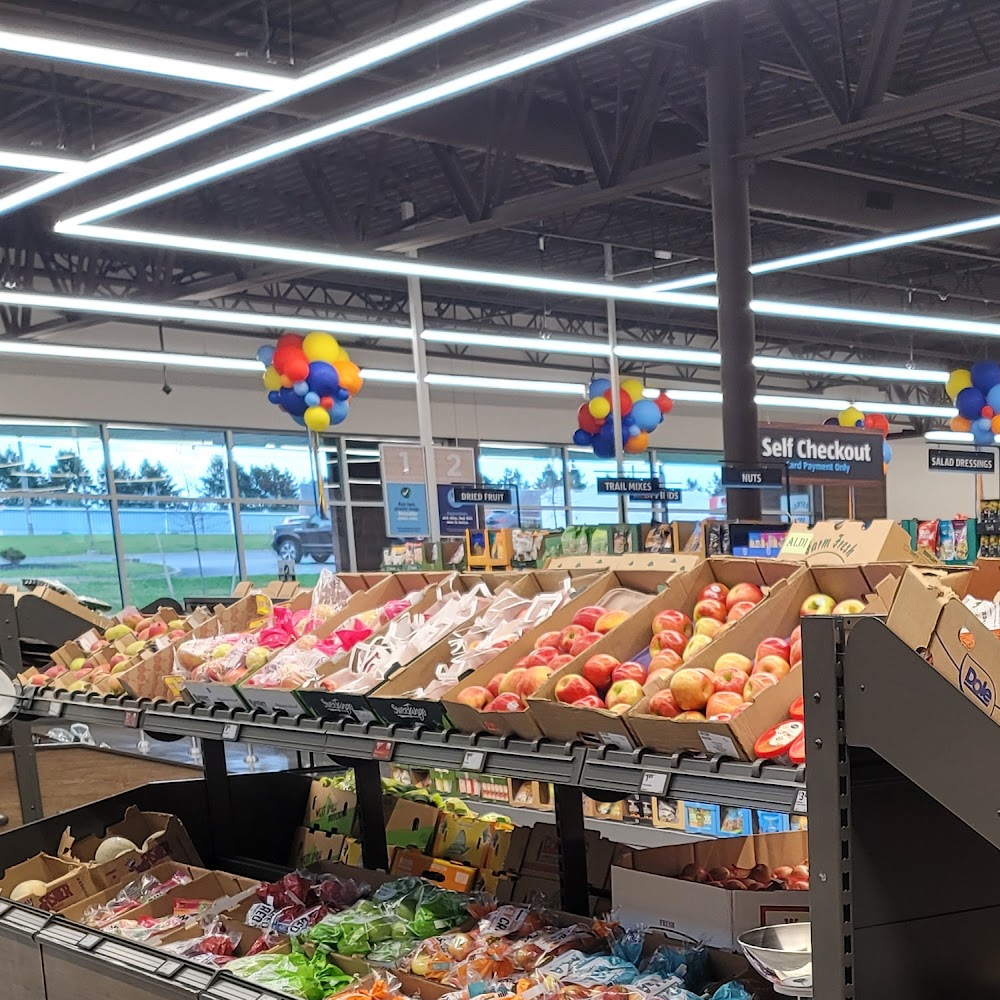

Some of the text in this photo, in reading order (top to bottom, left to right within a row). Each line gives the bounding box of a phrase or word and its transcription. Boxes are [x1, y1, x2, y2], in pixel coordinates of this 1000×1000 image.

[762, 437, 872, 462] Self Checkout
[399, 451, 410, 473] 1
[447, 454, 462, 477] 2
[803, 462, 834, 473] Payment
[835, 463, 850, 474] Only
[931, 457, 993, 469] SALAD DRESSINGS
[742, 473, 762, 483] NUTS
[605, 481, 652, 492] TRAIL MIXES
[461, 492, 505, 502] DRIED FRUIT
[786, 536, 809, 549] ALDI
[963, 665, 993, 708] Dole
[659, 919, 675, 928] FRESH
